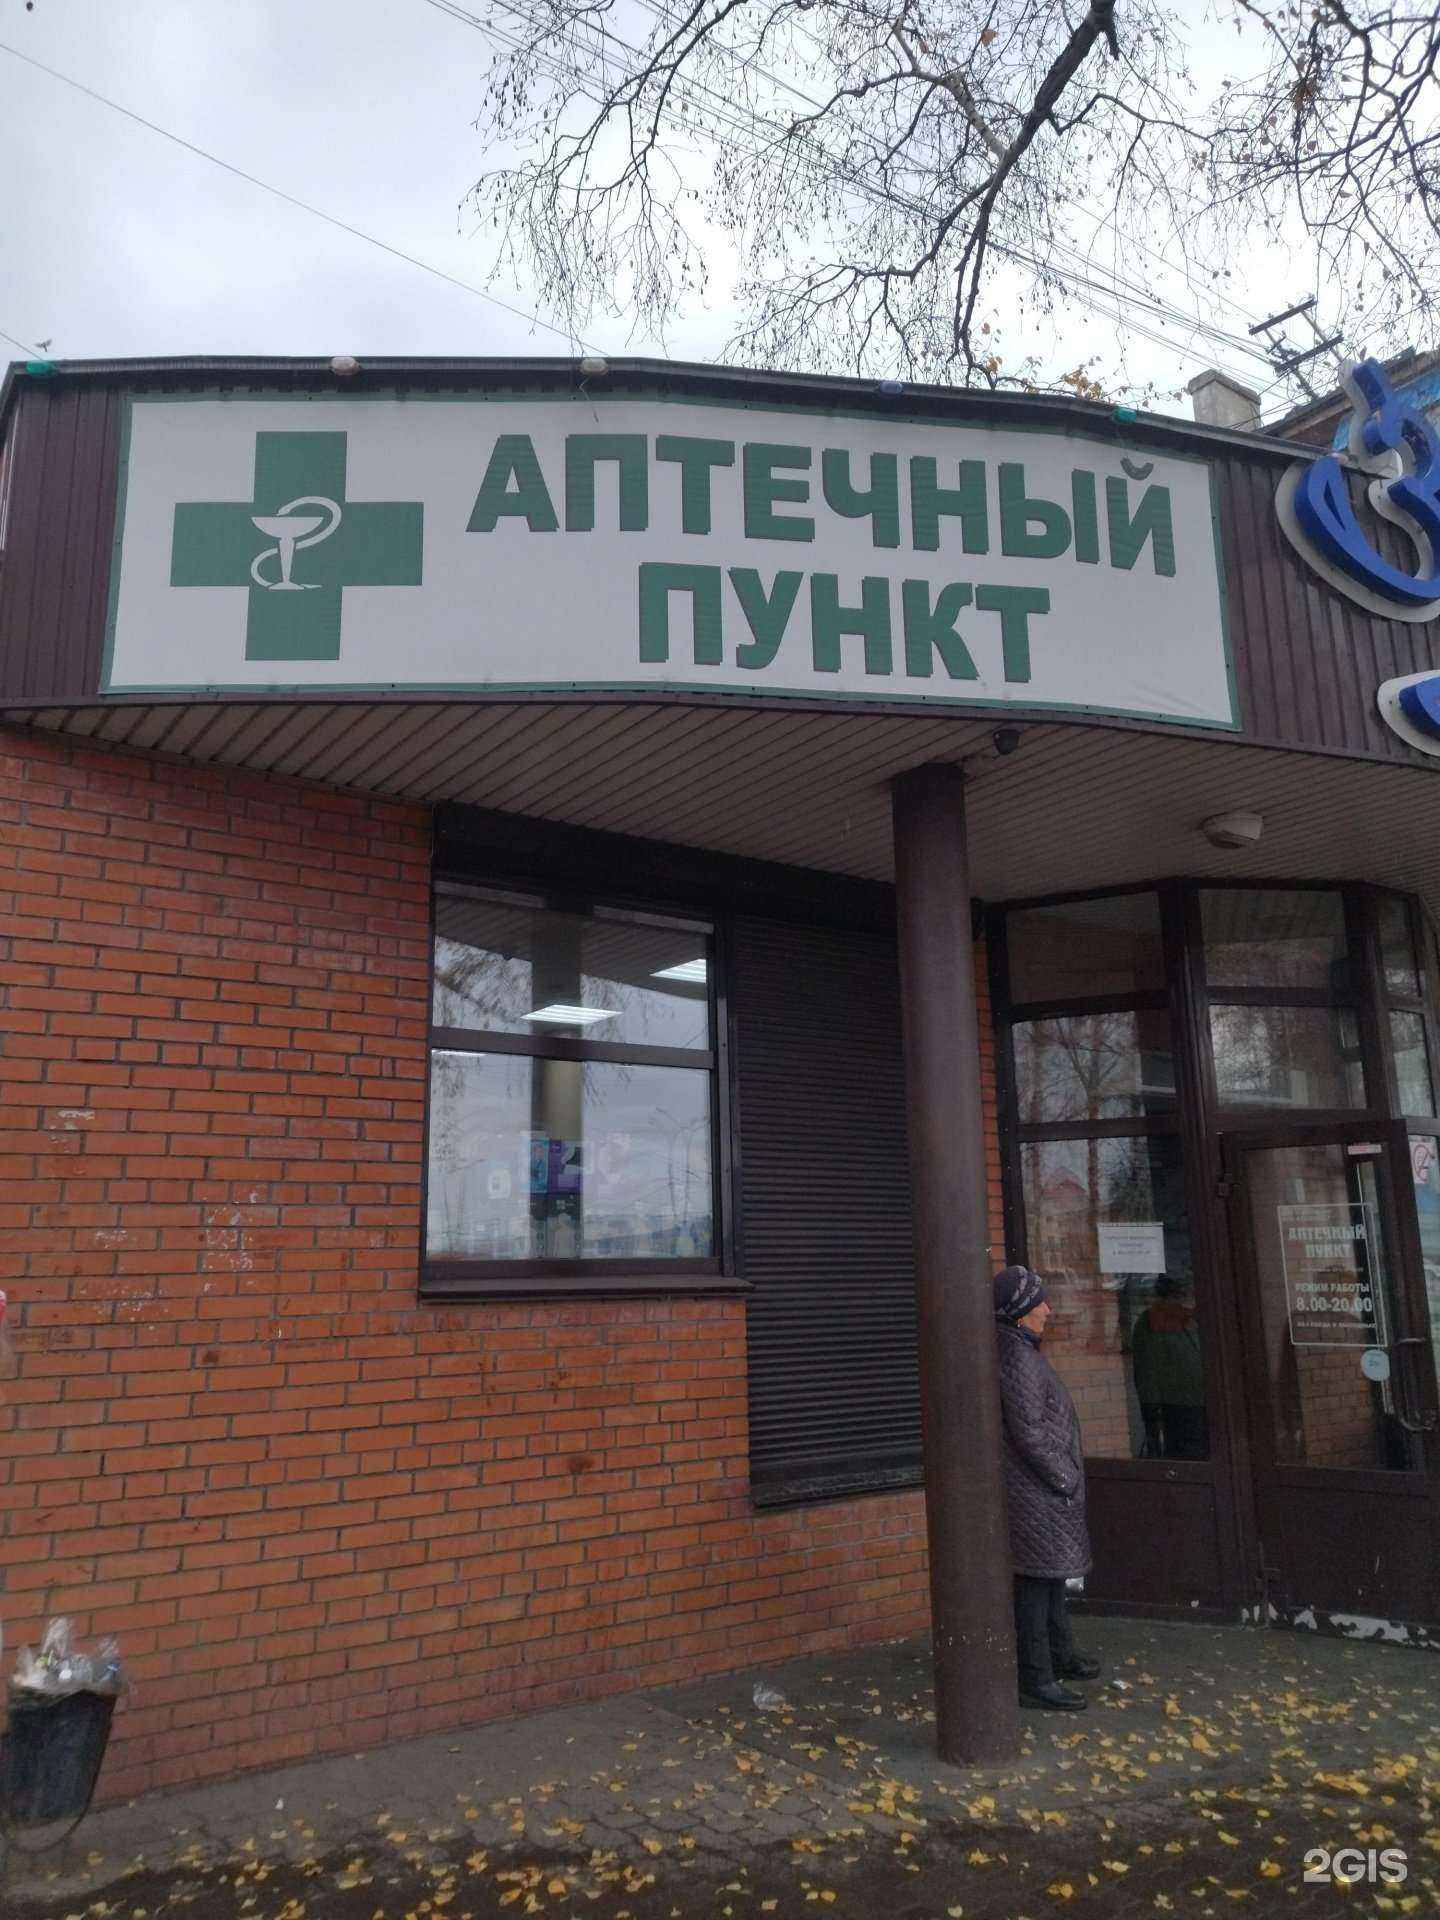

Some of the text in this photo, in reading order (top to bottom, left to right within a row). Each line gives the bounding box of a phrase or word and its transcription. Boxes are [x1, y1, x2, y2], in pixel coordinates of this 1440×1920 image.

[466, 434, 1176, 578] АПТЕЧНЫЙ
[638, 562, 1050, 683] ПУНКТ
[1288, 1224, 1368, 1240] АПТЕЧНЫЙ
[1305, 1244, 1351, 1258] ПУНКТ
[1331, 1283, 1370, 1293] РАБОТЫ
[1296, 1297, 1373, 1312] 8.00-20.00
